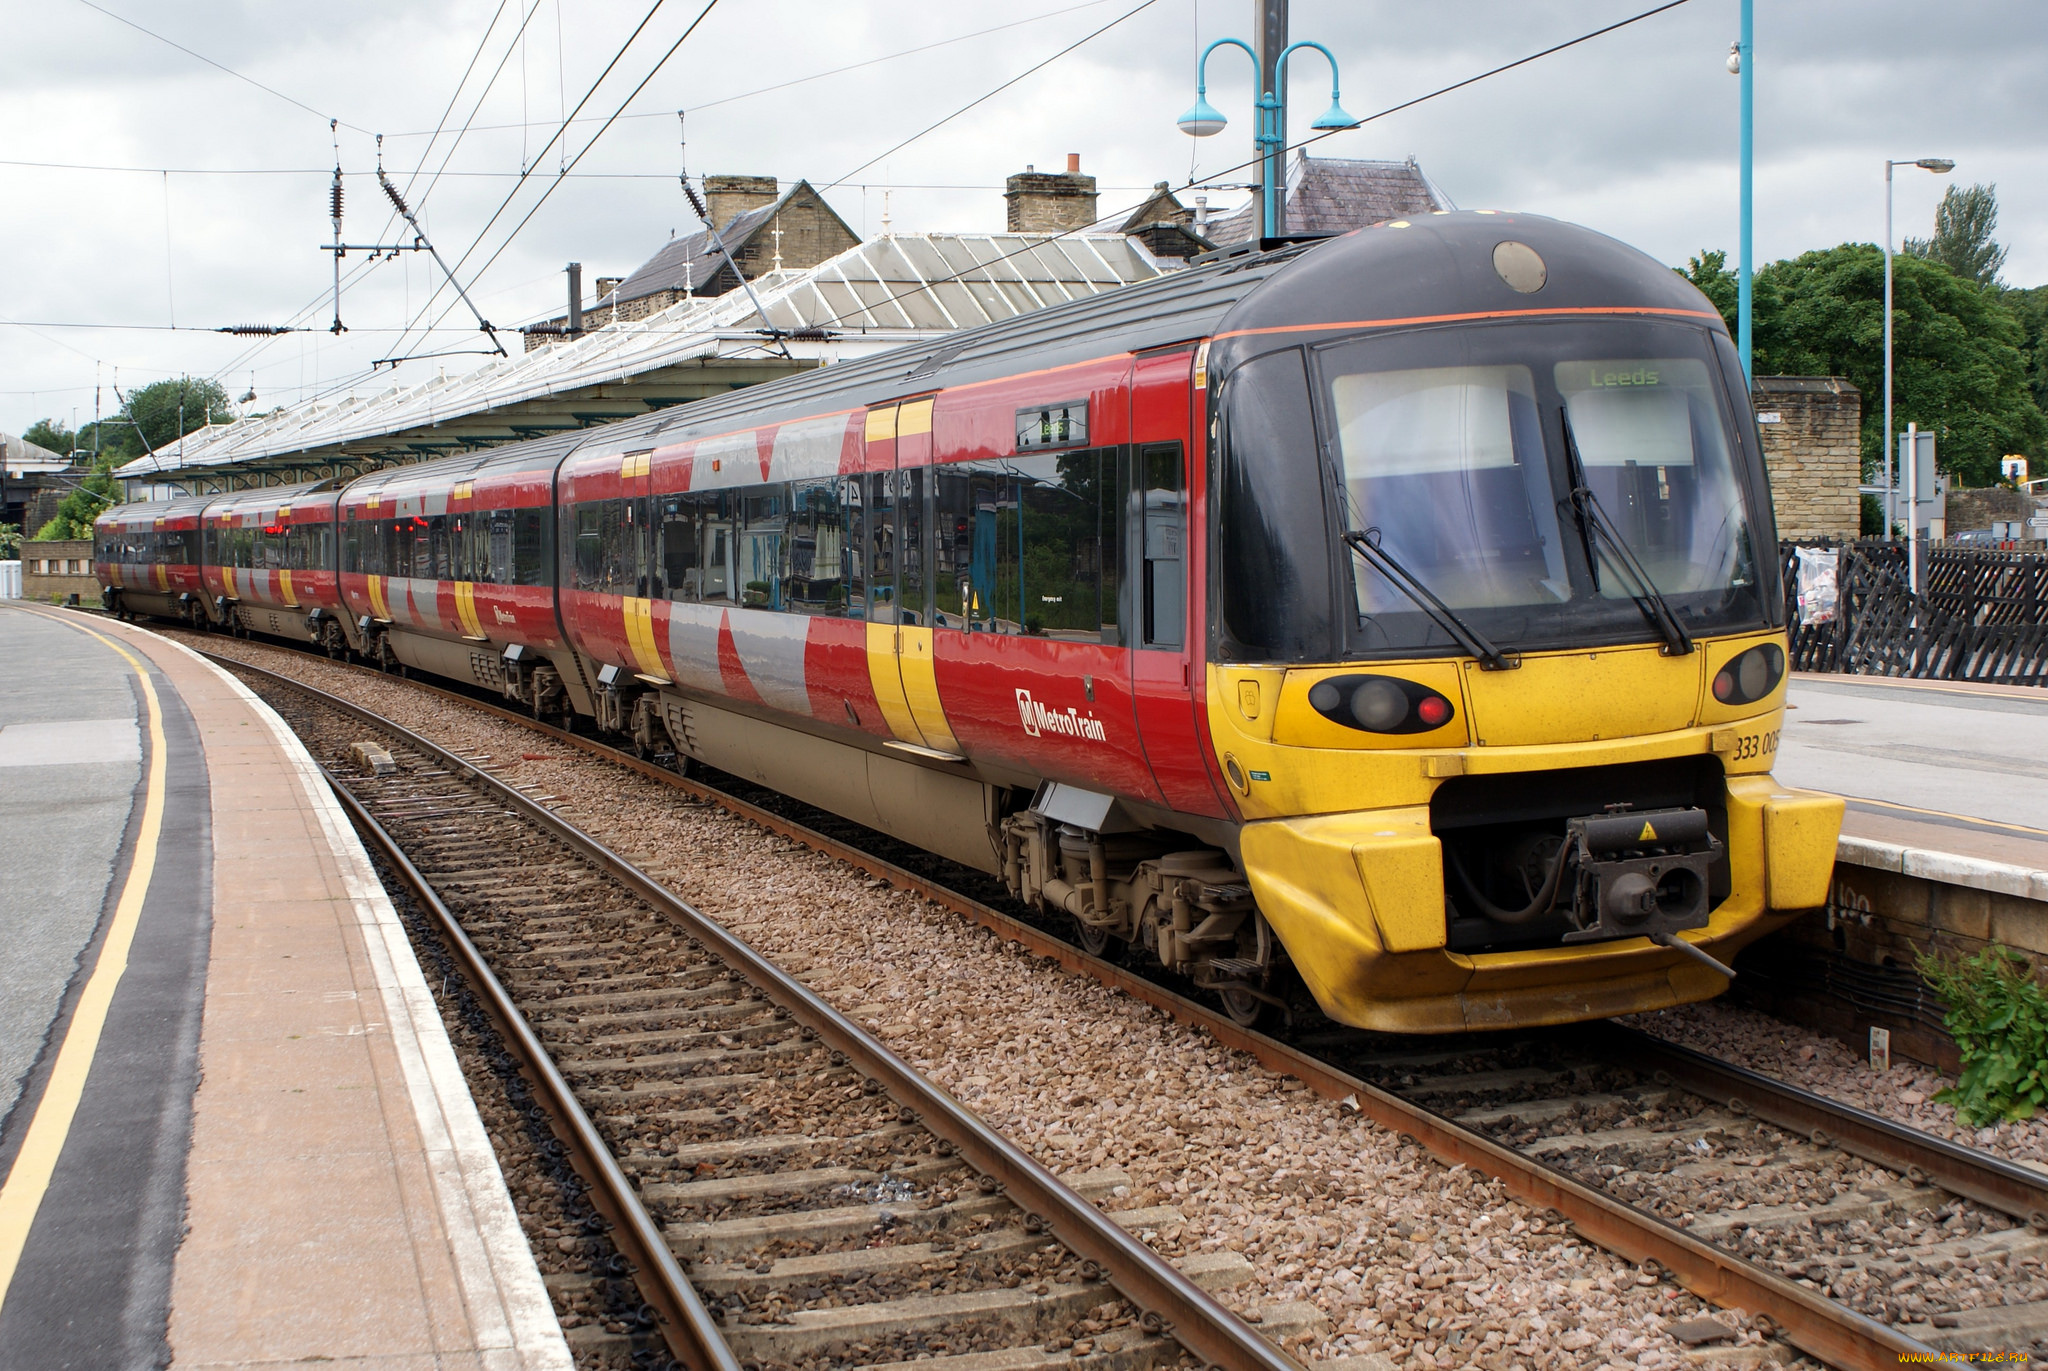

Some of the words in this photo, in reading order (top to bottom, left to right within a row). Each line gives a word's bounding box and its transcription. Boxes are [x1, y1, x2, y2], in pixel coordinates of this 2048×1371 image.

[1590, 368, 1660, 387] Leeds
[1033, 700, 1106, 742] MetroTrain
[1733, 734, 1760, 761] 333
